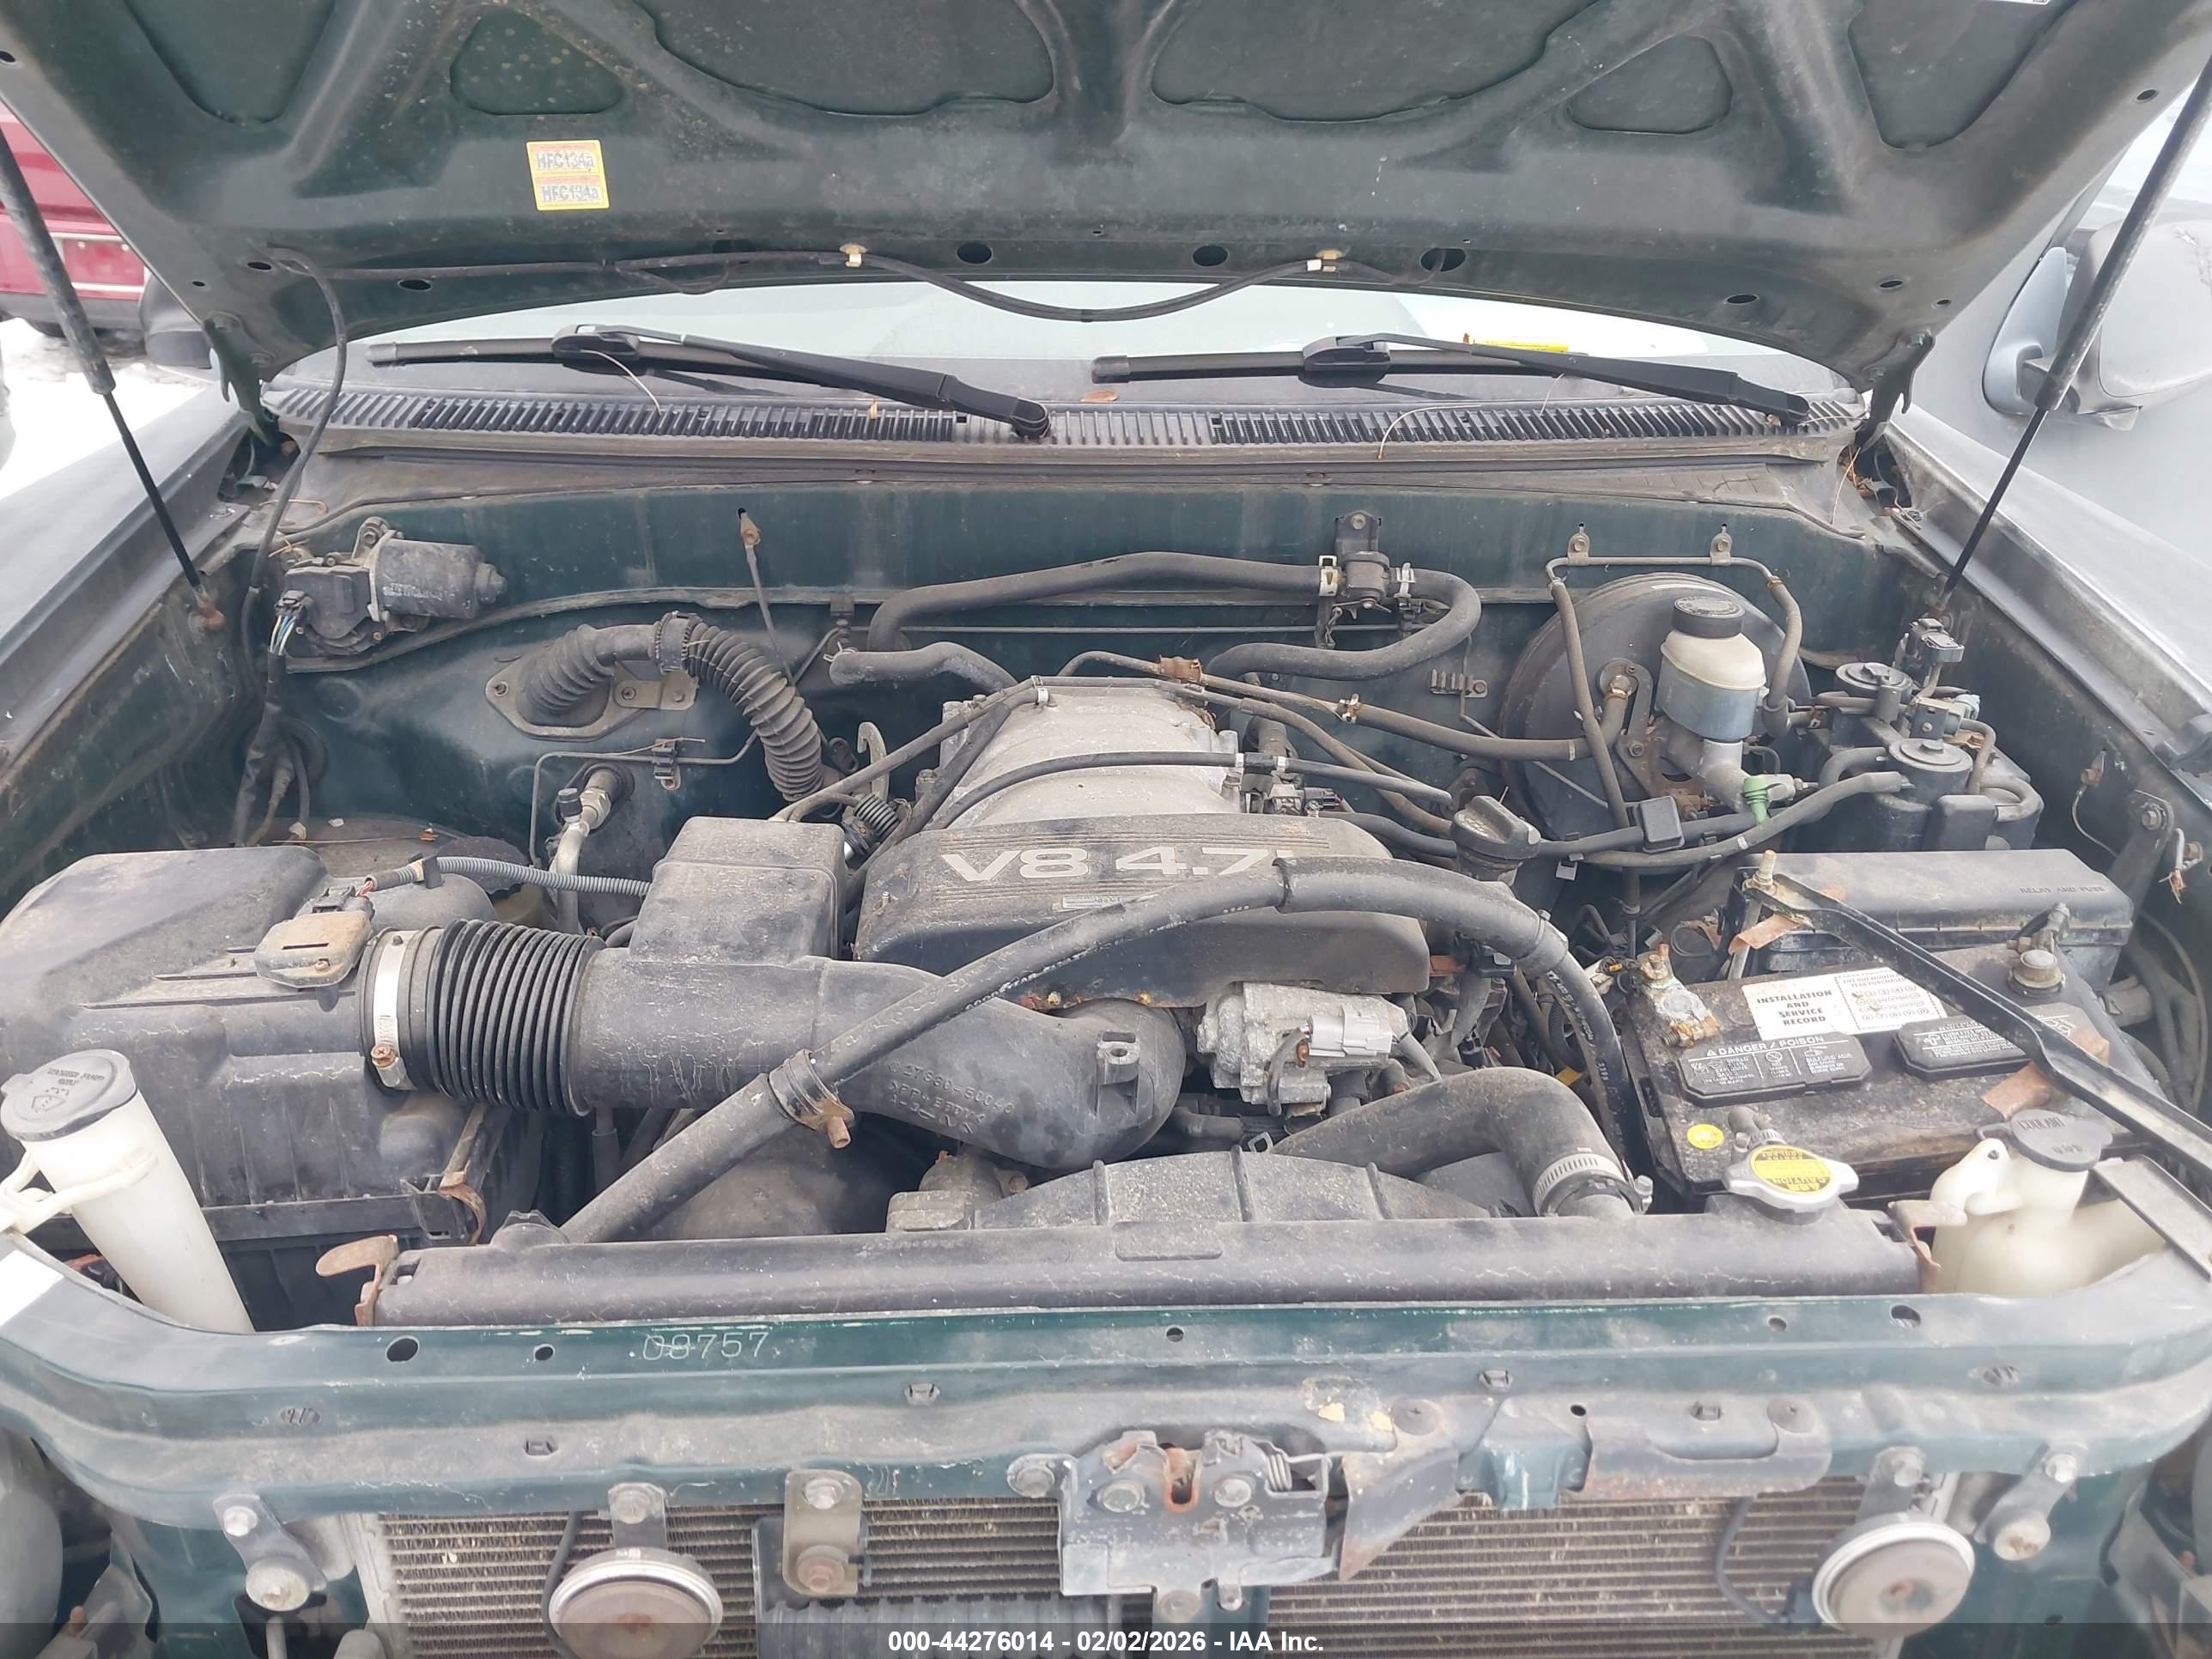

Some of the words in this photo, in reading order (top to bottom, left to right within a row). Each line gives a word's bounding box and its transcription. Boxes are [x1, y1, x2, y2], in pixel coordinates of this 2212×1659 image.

[536, 152, 594, 168] HFC134a
[542, 185, 599, 202] HFC134a
[942, 848, 1090, 882] V8
[1756, 989, 1832, 1005] INSTALLATION
[1786, 1000, 1809, 1009] AND
[1778, 1007, 1823, 1018] SERVICE
[1783, 1015, 1826, 1026] RECORD
[1718, 1042, 1767, 1056] DANGER
[1778, 1035, 1825, 1048] POISON
[1771, 1176, 1827, 1185] CAUTION
[643, 1332, 769, 1361] 08757
